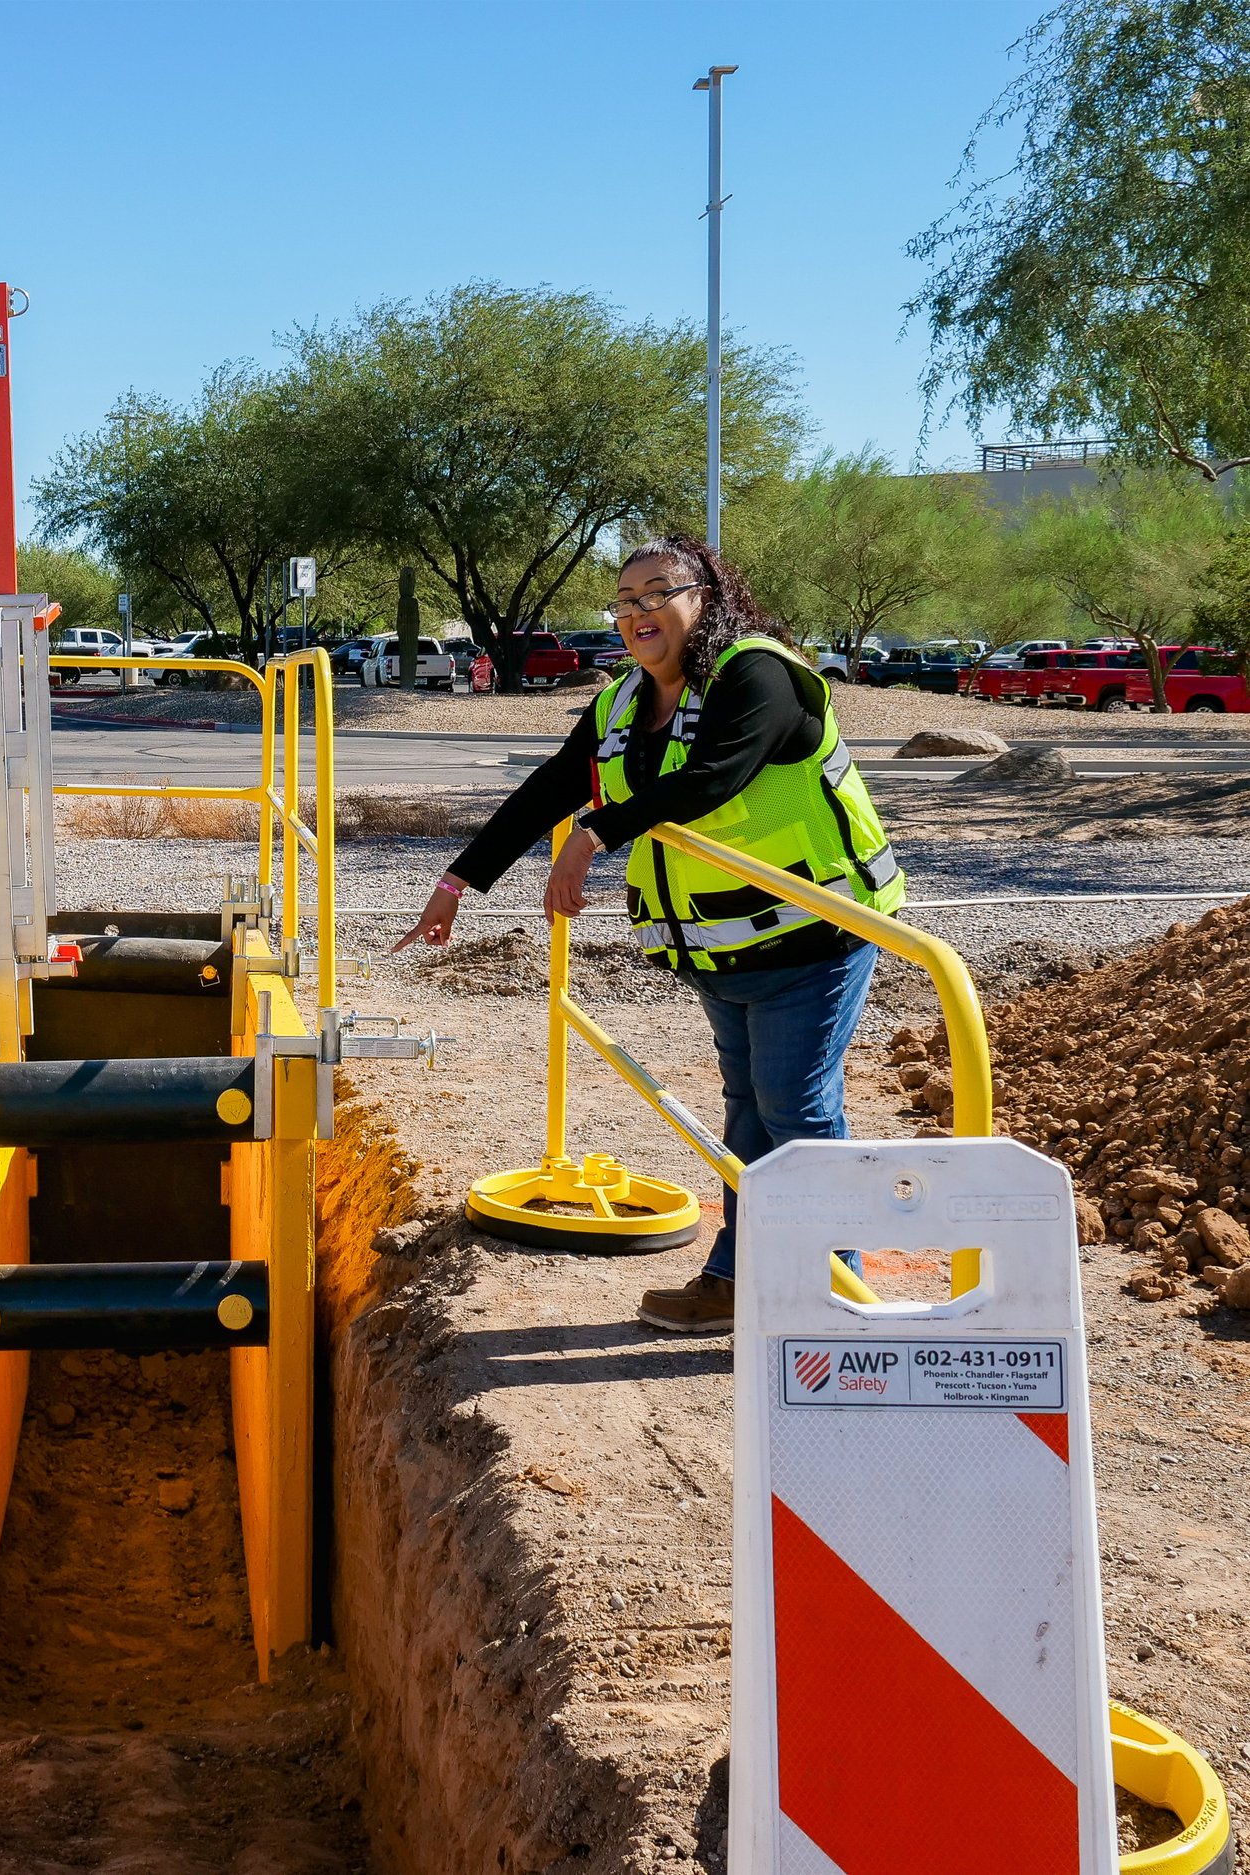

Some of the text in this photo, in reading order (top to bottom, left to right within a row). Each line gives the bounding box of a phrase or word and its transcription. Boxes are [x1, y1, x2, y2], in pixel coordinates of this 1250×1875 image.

[953, 1200, 1052, 1215] PLASTICADE
[838, 1351, 899, 1374] AWP
[913, 1350, 1055, 1367] 602-431-0911
[923, 1369, 1048, 1381] Phoenix Chandler Flagstaff
[838, 1375, 888, 1395] Safety
[935, 1381, 1037, 1391] Prescott Tucson Yuma
[943, 1392, 1029, 1403] Holbrook Kingman
